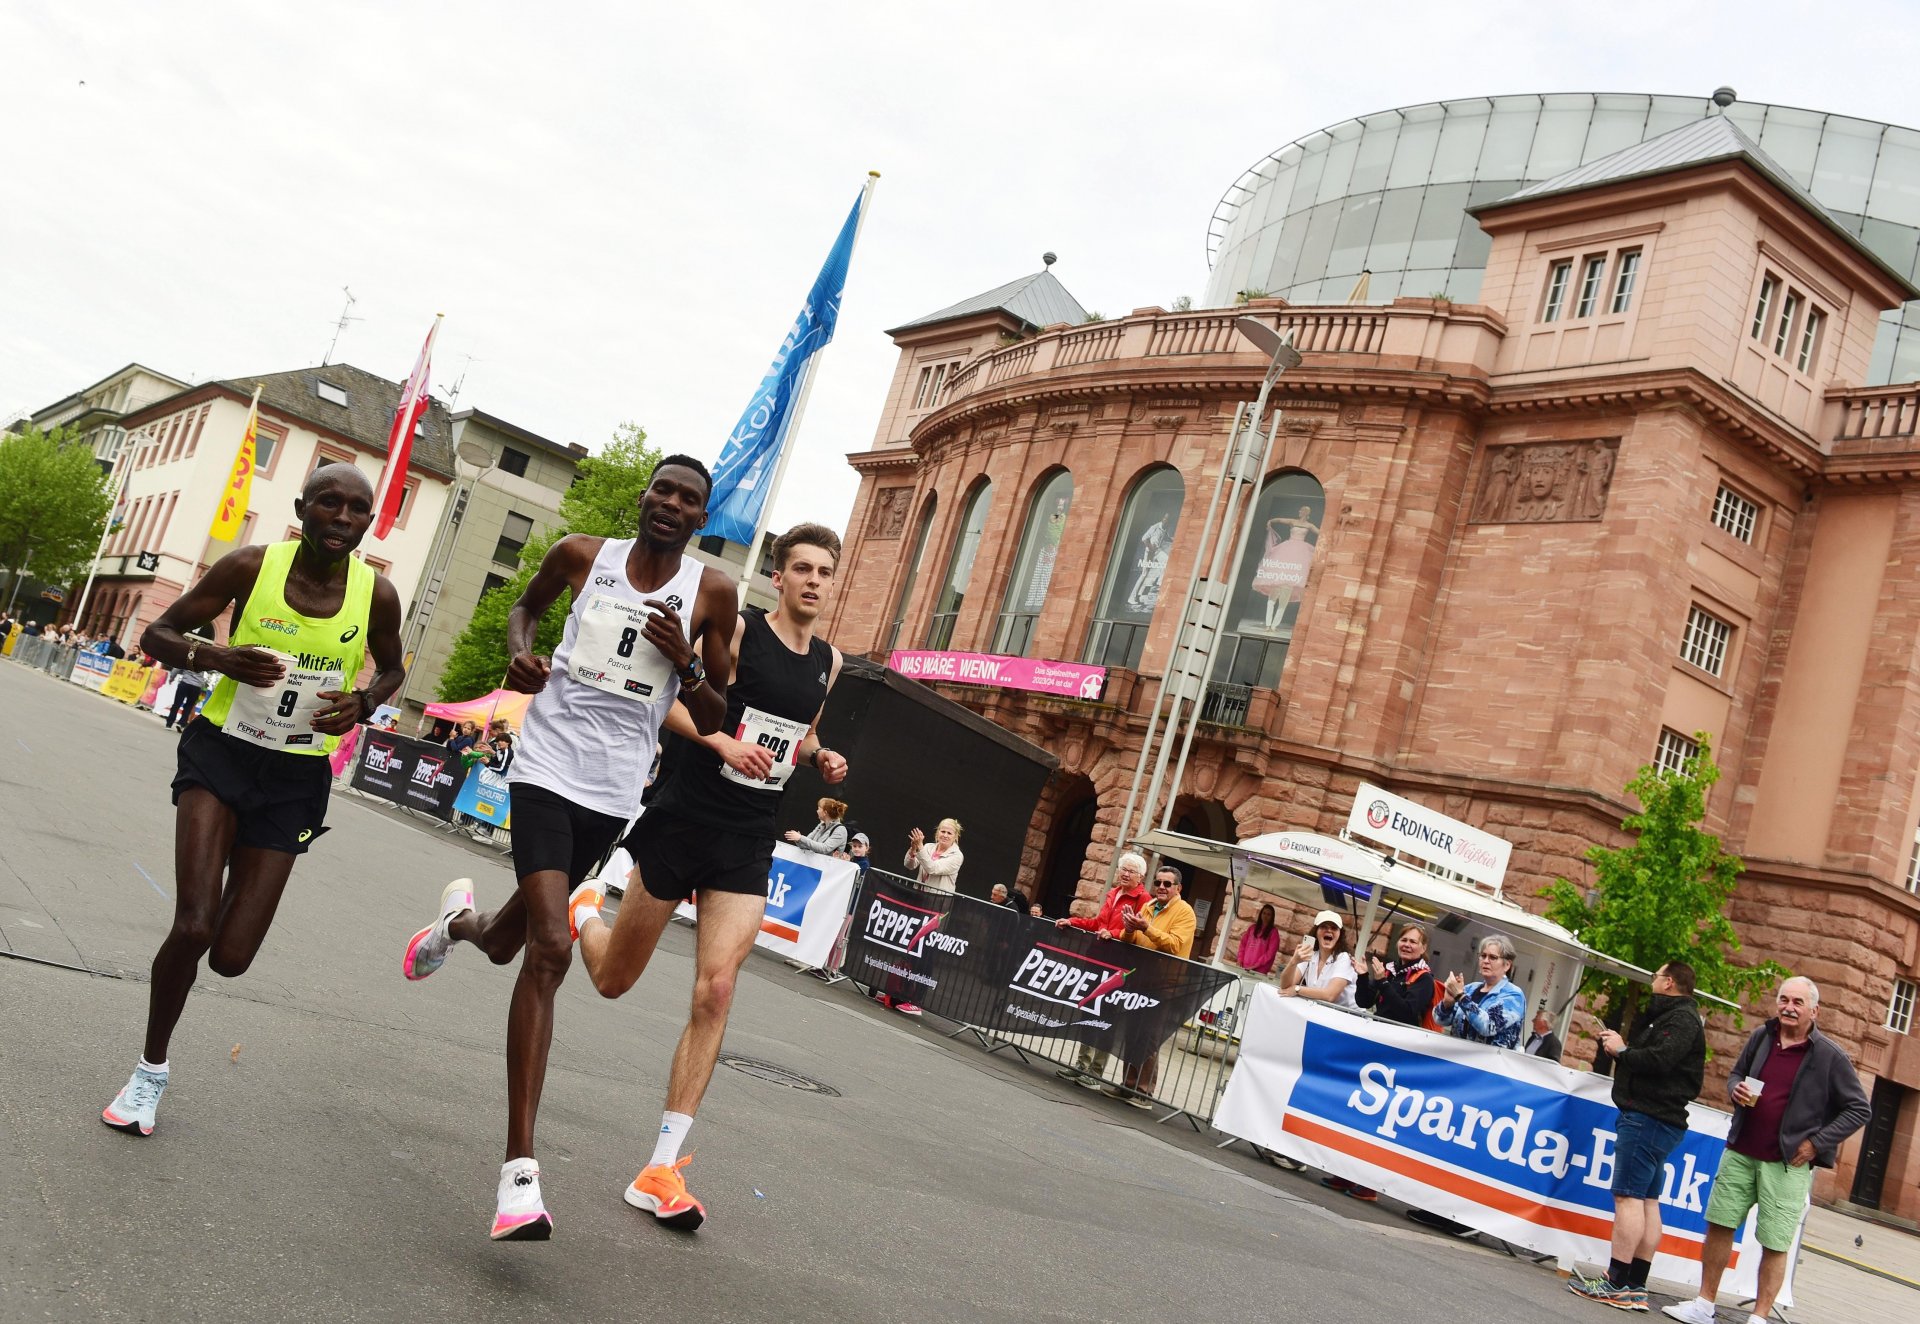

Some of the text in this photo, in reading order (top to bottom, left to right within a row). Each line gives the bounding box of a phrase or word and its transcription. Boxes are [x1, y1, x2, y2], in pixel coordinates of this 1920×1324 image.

[1262, 558, 1302, 571] Welcome
[595, 576, 616, 587] QAZ
[1256, 569, 1303, 583] Everybody
[614, 603, 638, 617] Gutenberg
[627, 615, 642, 624] Mainz
[617, 627, 638, 658] 8
[606, 658, 633, 672] Patrick
[900, 656, 921, 674] WAS
[922, 653, 956, 678] WÄRE,
[959, 658, 1000, 681] WENN
[1034, 666, 1045, 675] Das
[286, 678, 303, 687] Mainz
[298, 673, 321, 681] Marathon
[1032, 677, 1055, 686] 2023/24
[277, 690, 299, 717] 9
[265, 716, 296, 729] Dickson
[435, 772, 454, 786] SPORTS
[1391, 811, 1498, 870] ERDINGER Weißbier
[1290, 841, 1321, 856] ERDINGER
[925, 931, 969, 956] SPORTS
[1006, 1003, 1015, 1014] Ihr
[1014, 1005, 1039, 1023] Spezialist
[1038, 1013, 1048, 1025] für
[1347, 1062, 1710, 1213] Sparda-Bnk
